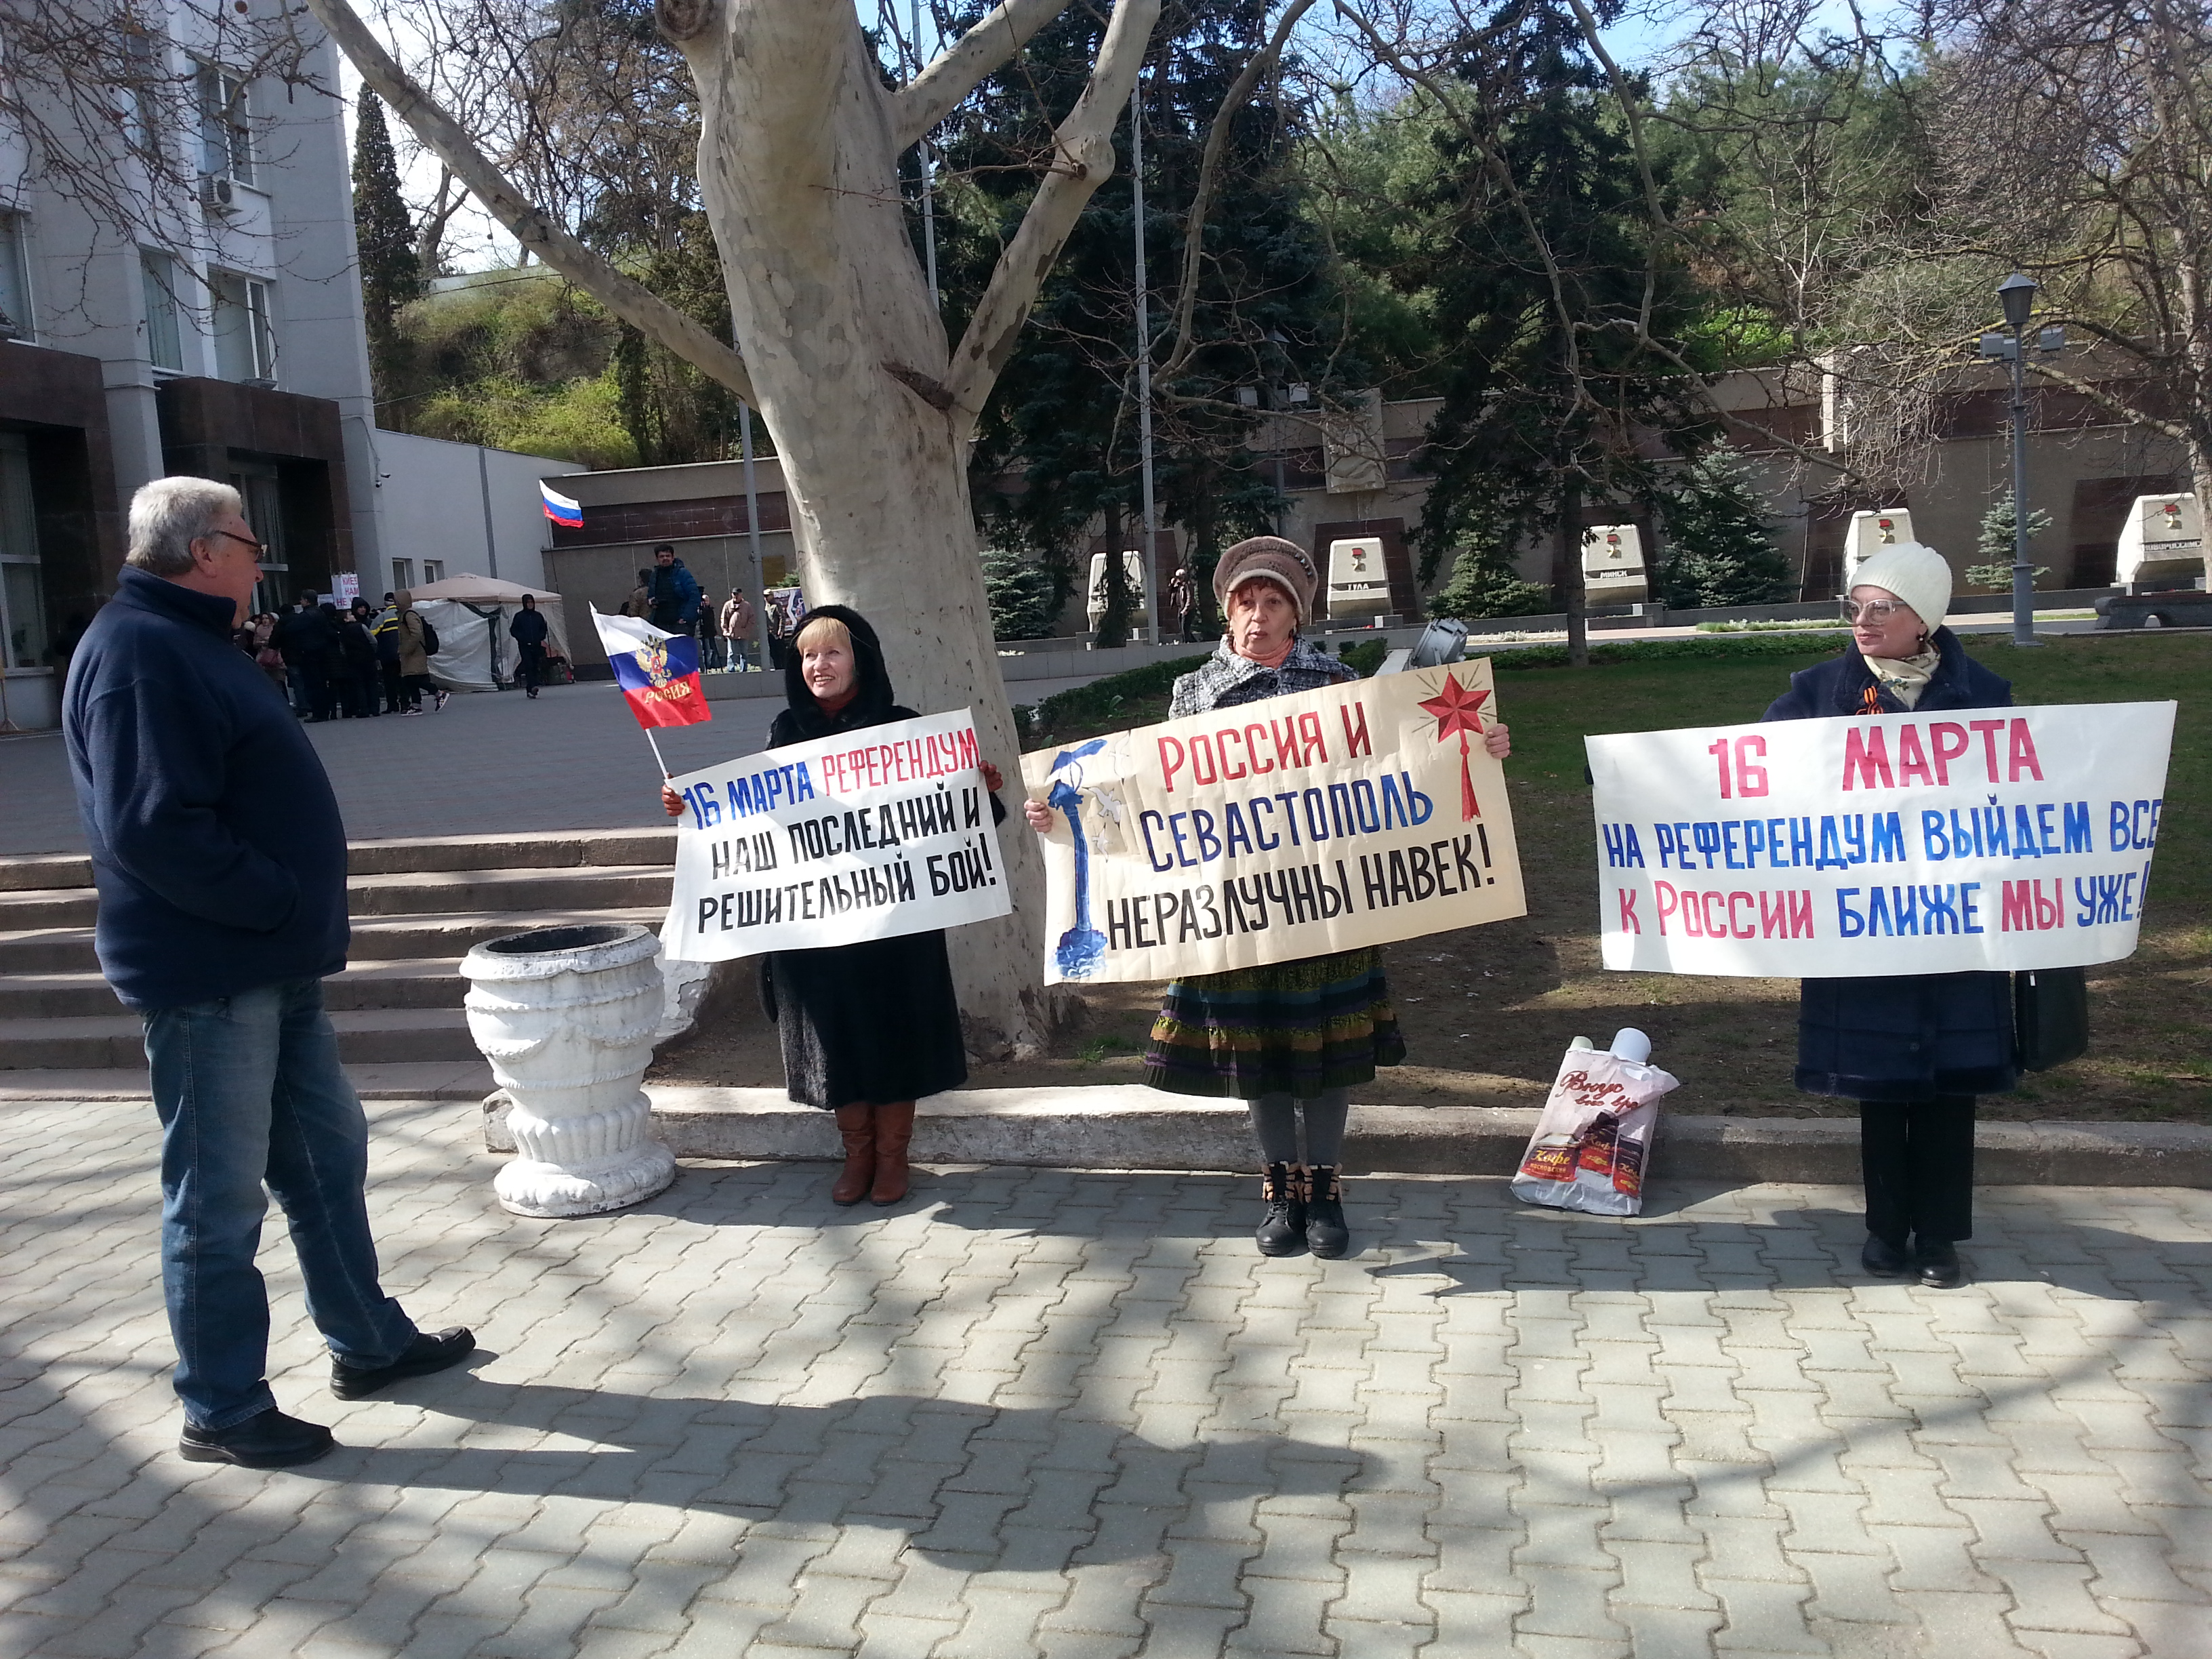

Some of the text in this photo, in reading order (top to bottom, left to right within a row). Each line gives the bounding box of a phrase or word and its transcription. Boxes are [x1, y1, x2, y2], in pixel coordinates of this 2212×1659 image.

[336, 598, 347, 606] НЕ
[682, 727, 980, 830] 16 МАРТА РЕФЕРЕНДУМ
[1158, 701, 1372, 792] РОССИЯ И
[1708, 717, 2044, 799] 16 МАРТА
[711, 781, 981, 880] НАШ ПОСЛЕДНИЙ И
[1139, 771, 1434, 872] СЕВАСТОПОЛЬ
[1602, 793, 2162, 872] НА РЕФЕРЕНДУМ ВЫЙДЕМ ВСЕ
[698, 832, 997, 934] РЕШИТЕЛЬНЫЙ БОЙ!
[1107, 823, 1495, 950] НЕРАЗЛУЧНЫ НАВЕК!
[1618, 888, 1641, 935] К
[1837, 882, 1985, 938] БЛИЖЕ
[2002, 878, 2064, 933] МЫ
[2074, 861, 2151, 927] УЖЕ!
[1531, 1149, 1570, 1166] Кофе
